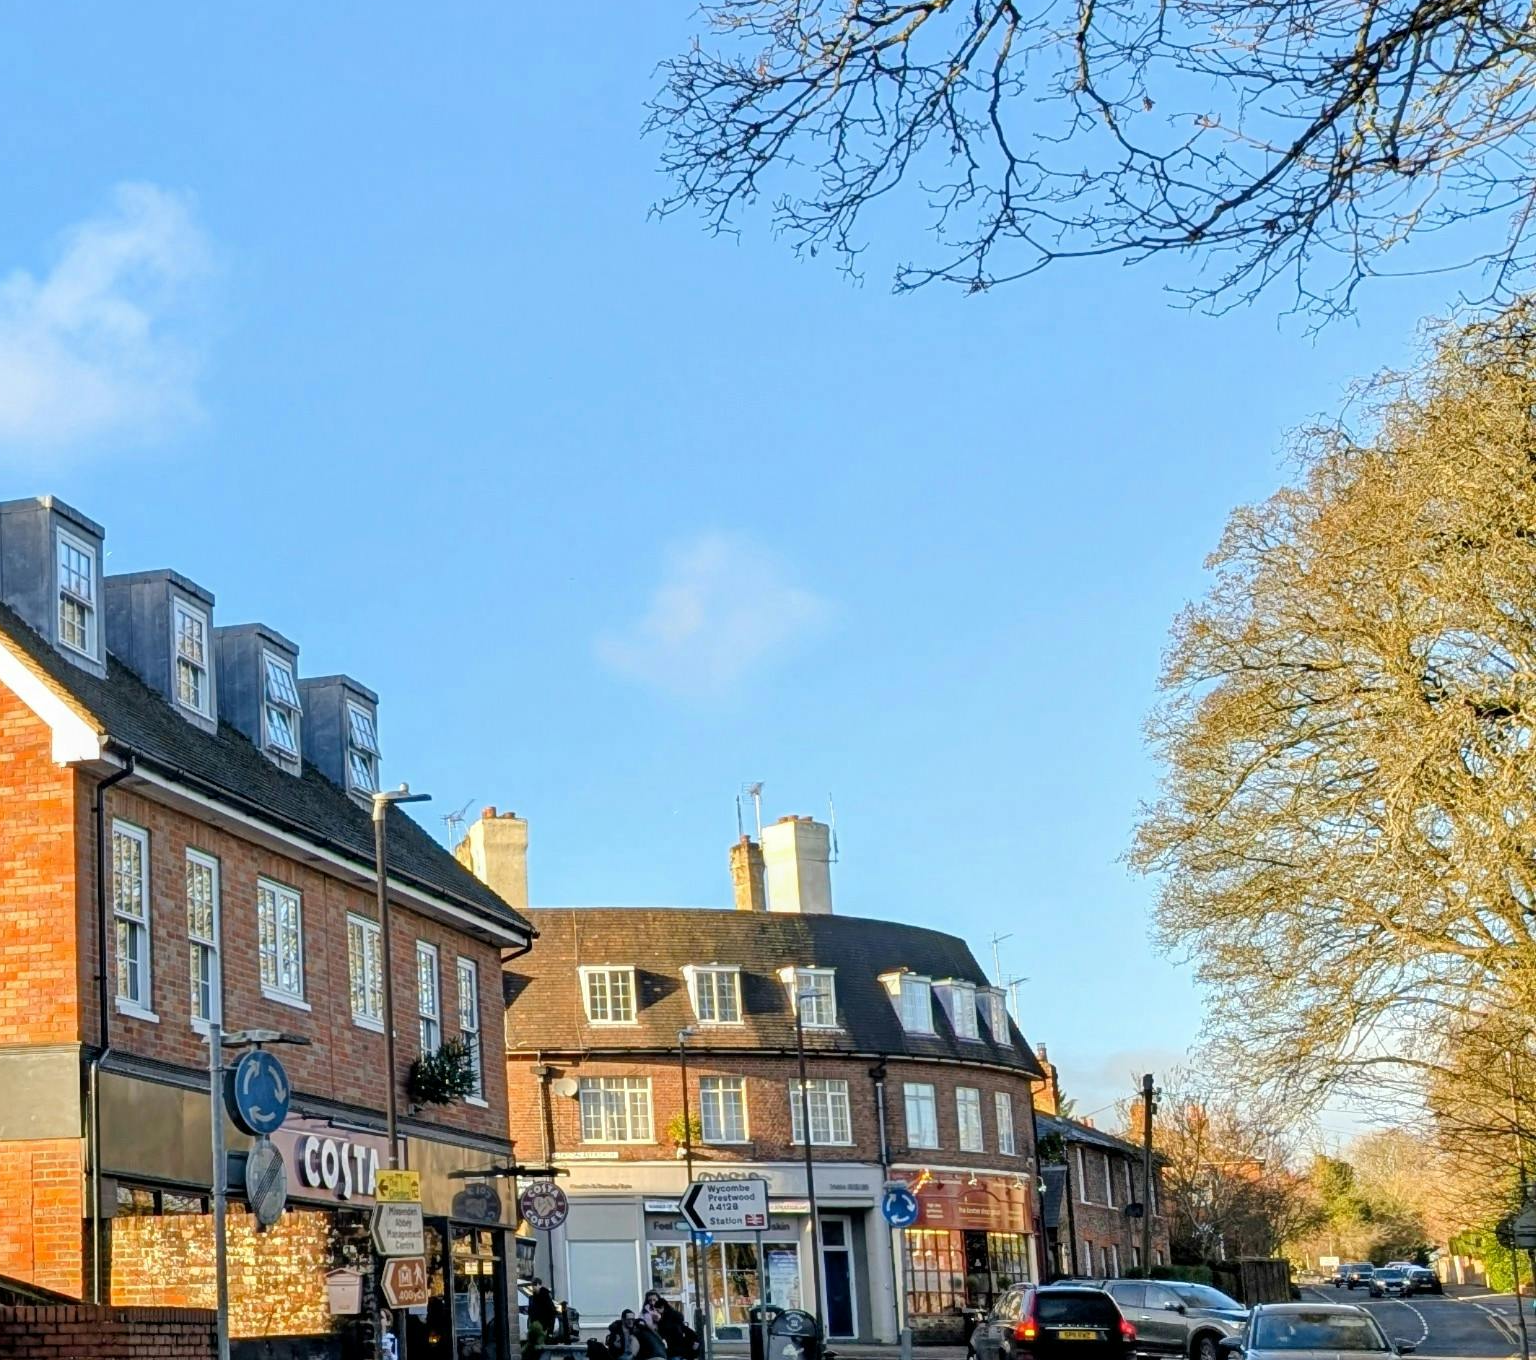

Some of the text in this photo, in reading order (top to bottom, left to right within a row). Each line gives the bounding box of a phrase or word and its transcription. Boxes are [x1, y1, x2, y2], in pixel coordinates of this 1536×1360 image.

[304, 1135, 380, 1200] COSTA
[527, 1183, 559, 1198] COSTA
[707, 1184, 750, 1194] Wycombe
[708, 1193, 755, 1201] Prestwood
[525, 1210, 563, 1227] COFFEE
[710, 1217, 743, 1225] Station
